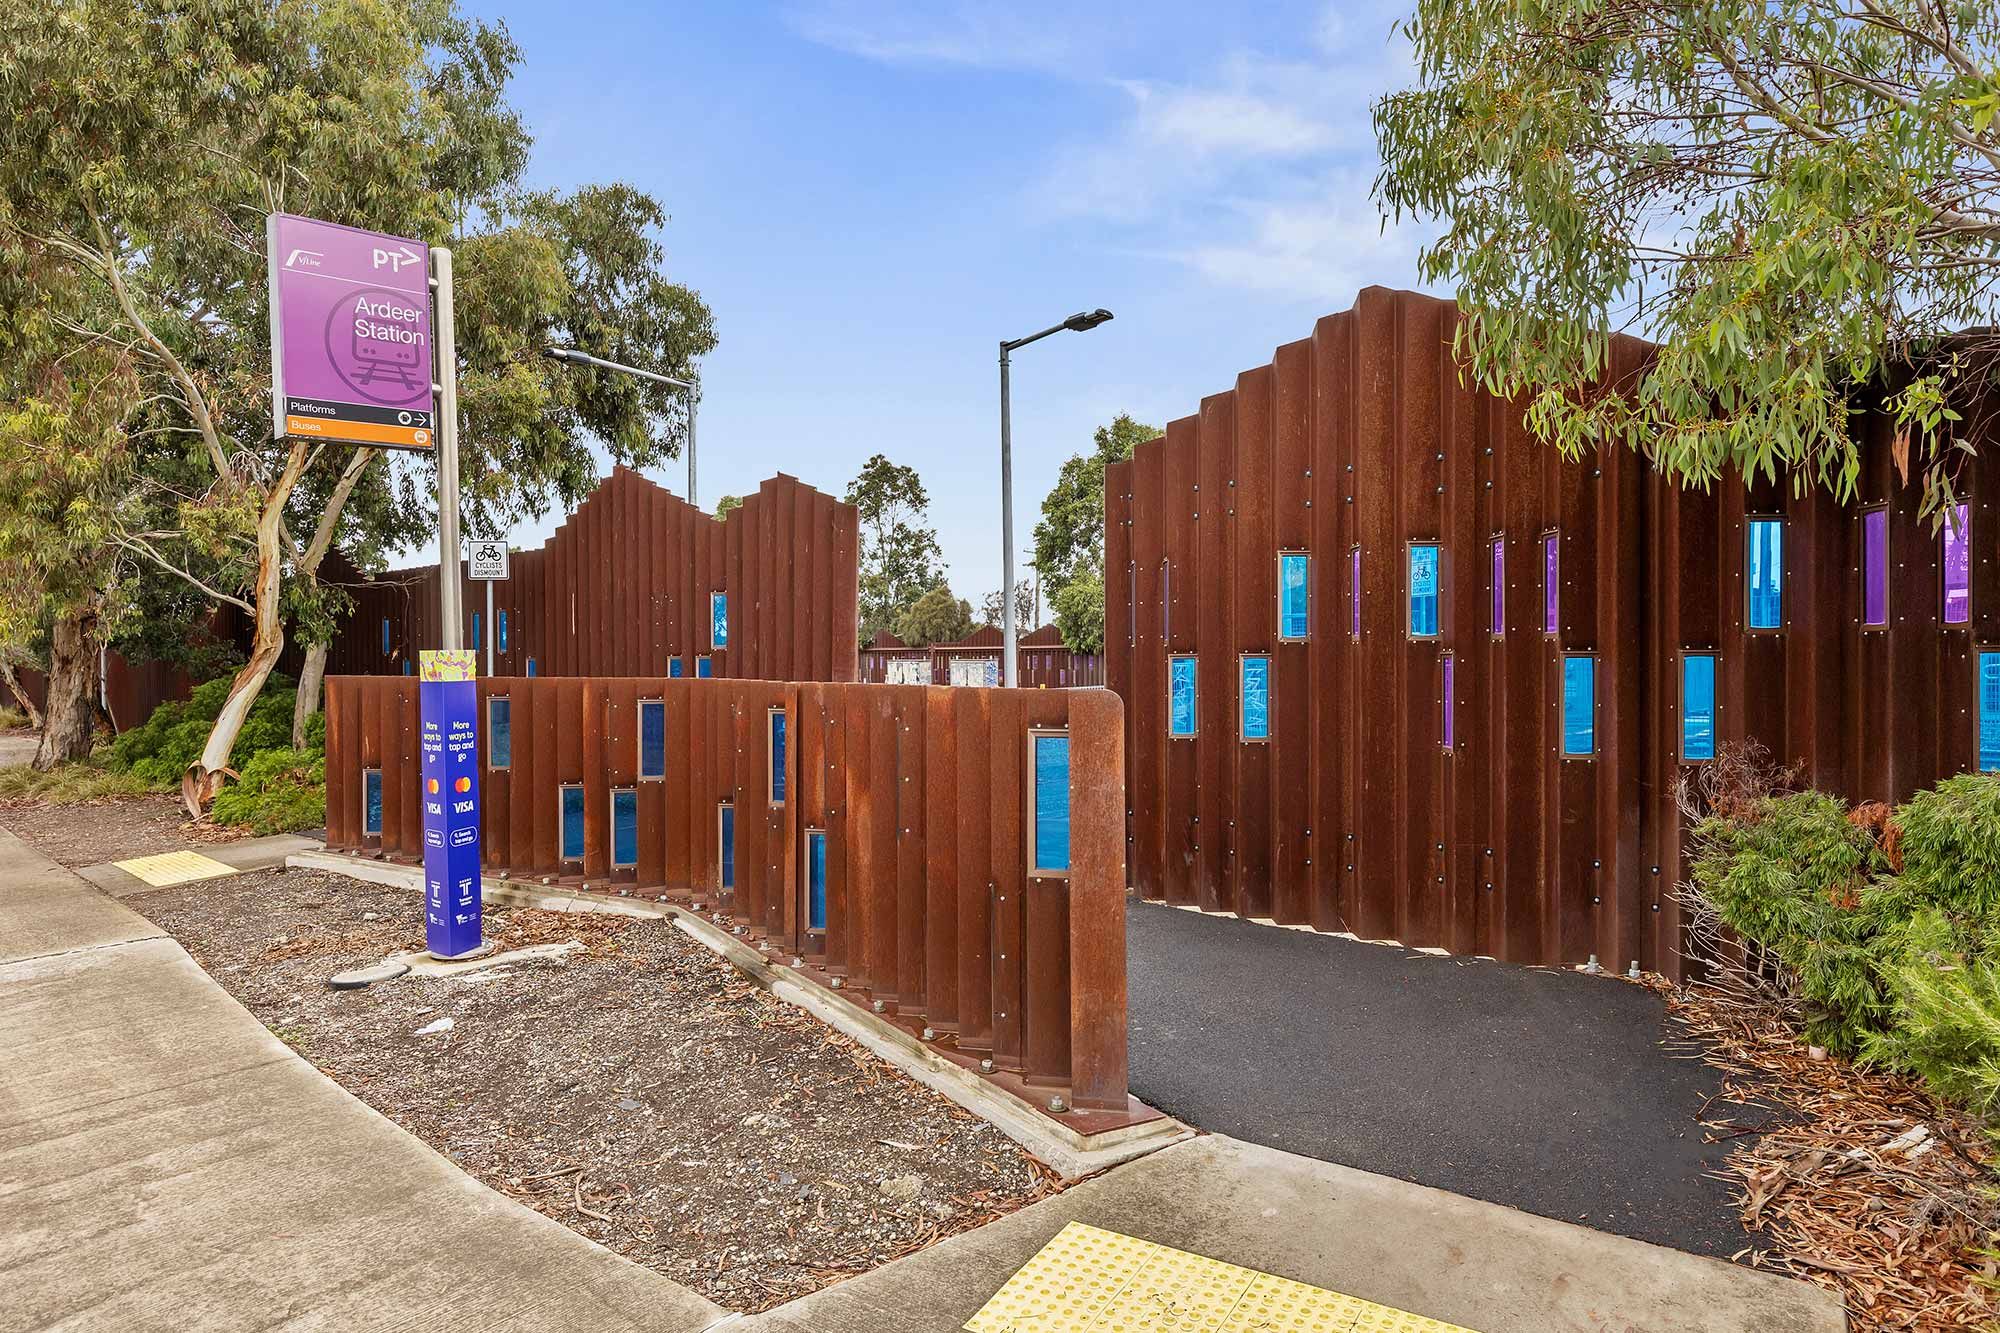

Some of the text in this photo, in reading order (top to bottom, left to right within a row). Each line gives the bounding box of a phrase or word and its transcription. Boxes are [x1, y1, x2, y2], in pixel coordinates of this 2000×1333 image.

[355, 297, 423, 323] Ardeer
[355, 319, 425, 346] Station
[290, 401, 336, 415] Platforms
[291, 420, 321, 432] Buses
[452, 721, 470, 730] More
[448, 731, 474, 742] ways to
[449, 740, 474, 752] tap and
[457, 753, 467, 763] go
[426, 802, 442, 815] VISA
[453, 800, 474, 814] VISA
